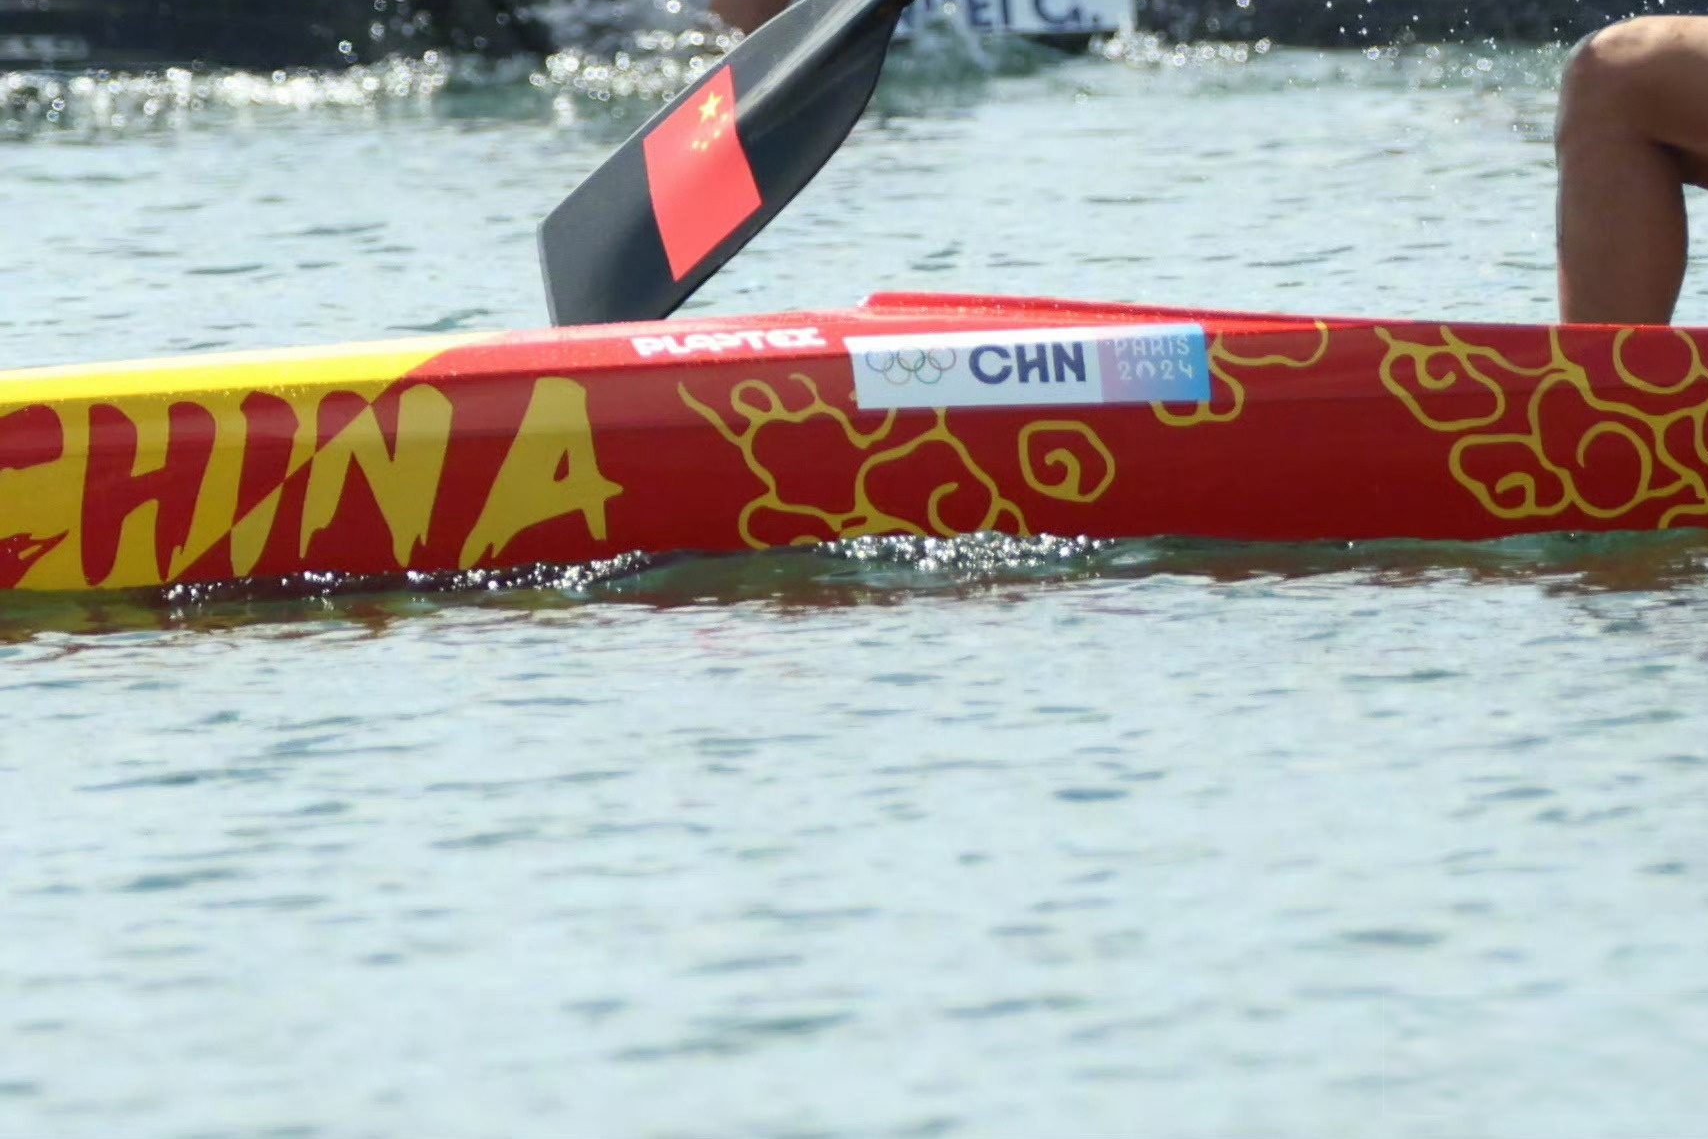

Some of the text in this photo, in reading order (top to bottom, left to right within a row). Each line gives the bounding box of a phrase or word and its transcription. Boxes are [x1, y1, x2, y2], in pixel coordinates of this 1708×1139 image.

[1114, 334, 1191, 358] PARIS
[968, 341, 1087, 386] CHN
[1118, 359, 1193, 381] 2024
